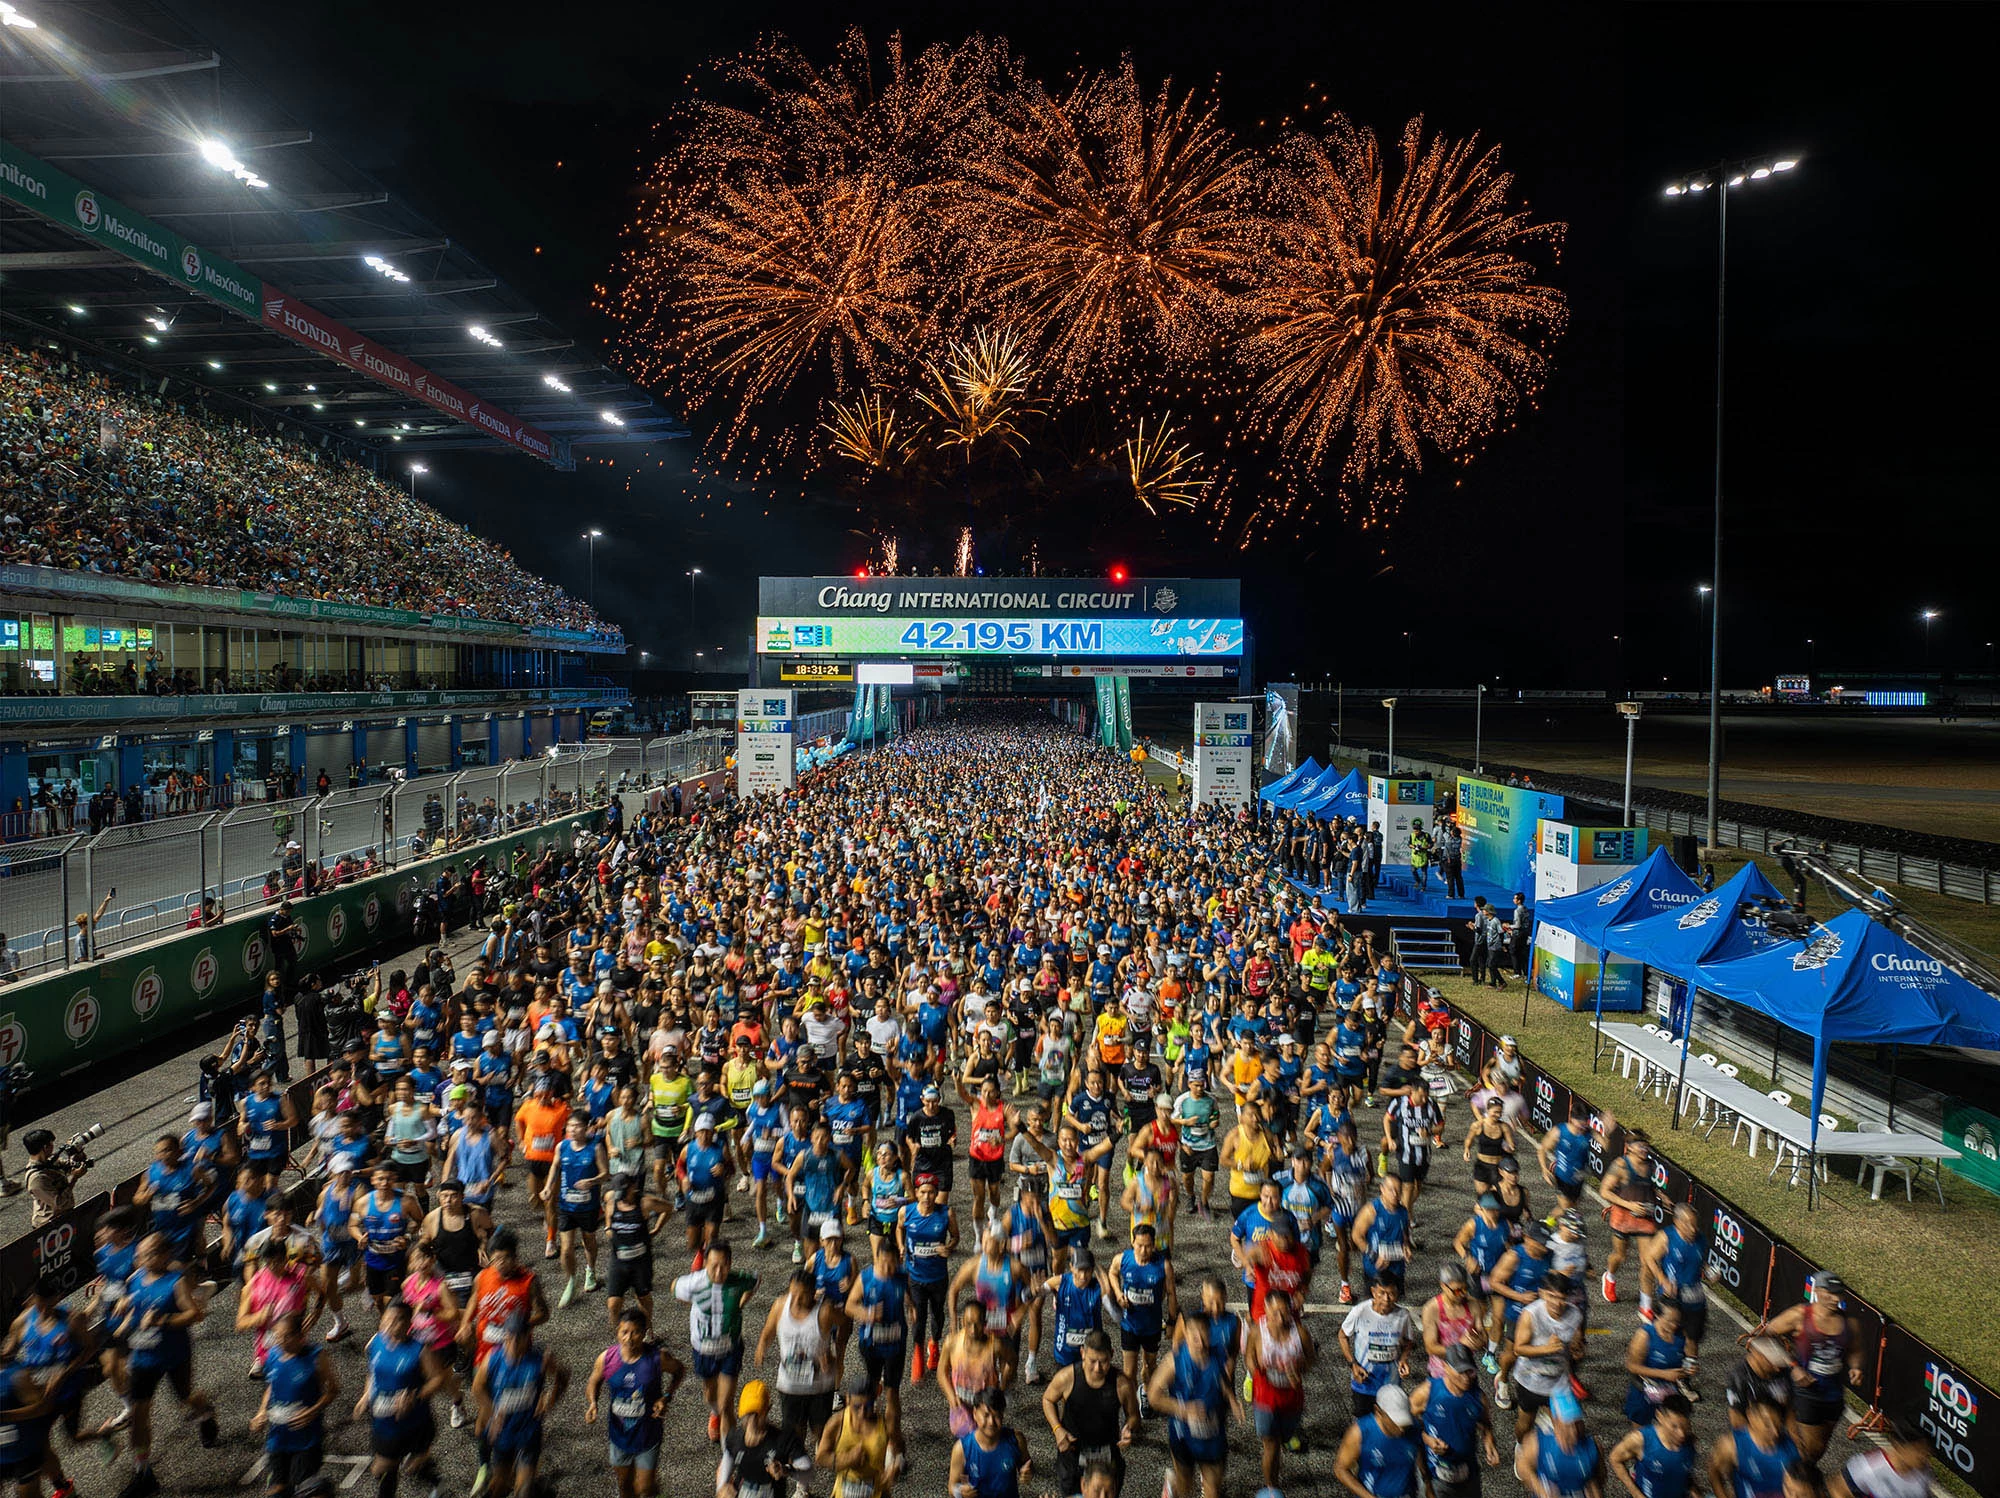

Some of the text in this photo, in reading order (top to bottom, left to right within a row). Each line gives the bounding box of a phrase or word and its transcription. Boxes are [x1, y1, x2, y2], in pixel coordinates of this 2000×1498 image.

[105, 214, 167, 260] Maxnitron
[205, 266, 254, 304] Maxnitron
[284, 310, 342, 353] HONDA
[363, 352, 411, 387] HONDA
[426, 383, 464, 414] HONDA
[478, 410, 511, 438] HONDA
[522, 434, 549, 455] HONDA
[818, 586, 1134, 612] Chang INTERNATIONAL CIRCUIT
[900, 621, 1103, 650] 42.195 KM
[796, 665, 839, 675] 18:31:24
[1022, 666, 1041, 674] Chang
[68, 703, 110, 716] CIRCUIT
[260, 695, 356, 711] Chang INTERNATIONAL CIRCUIT
[199, 729, 214, 740] 22
[278, 725, 290, 735] 23
[342, 720, 353, 731] 24
[743, 721, 786, 732] START
[102, 735, 117, 747] 21
[1205, 735, 1247, 746] START
[1345, 791, 1368, 799] Chan
[1476, 786, 1503, 803] BURIRAM
[1458, 811, 1466, 825] 24
[1475, 799, 1510, 818] MARATHON
[248, 942, 263, 969] PT
[1871, 953, 1942, 976] Chang
[198, 960, 213, 988] PT
[1878, 975, 1951, 985] INTERNATIONAL
[1899, 982, 1937, 990] CIRCUIT
[139, 980, 158, 1010] PT
[73, 1002, 94, 1035] PT
[1459, 1019, 1472, 1041] 100
[1455, 1045, 1471, 1065] PRO
[1537, 1075, 1554, 1103] 100
[1536, 1096, 1552, 1114] PLUS
[1532, 1107, 1553, 1132] PRO
[1717, 1208, 1741, 1247] 100
[37, 1223, 74, 1264] 100
[1715, 1235, 1738, 1262] PLUS
[40, 1250, 72, 1279] PLUS
[1708, 1248, 1741, 1288] PRO
[1931, 1362, 1973, 1417] 100
[1929, 1397, 1968, 1438] PLUS
[1919, 1412, 1974, 1473] PRO
